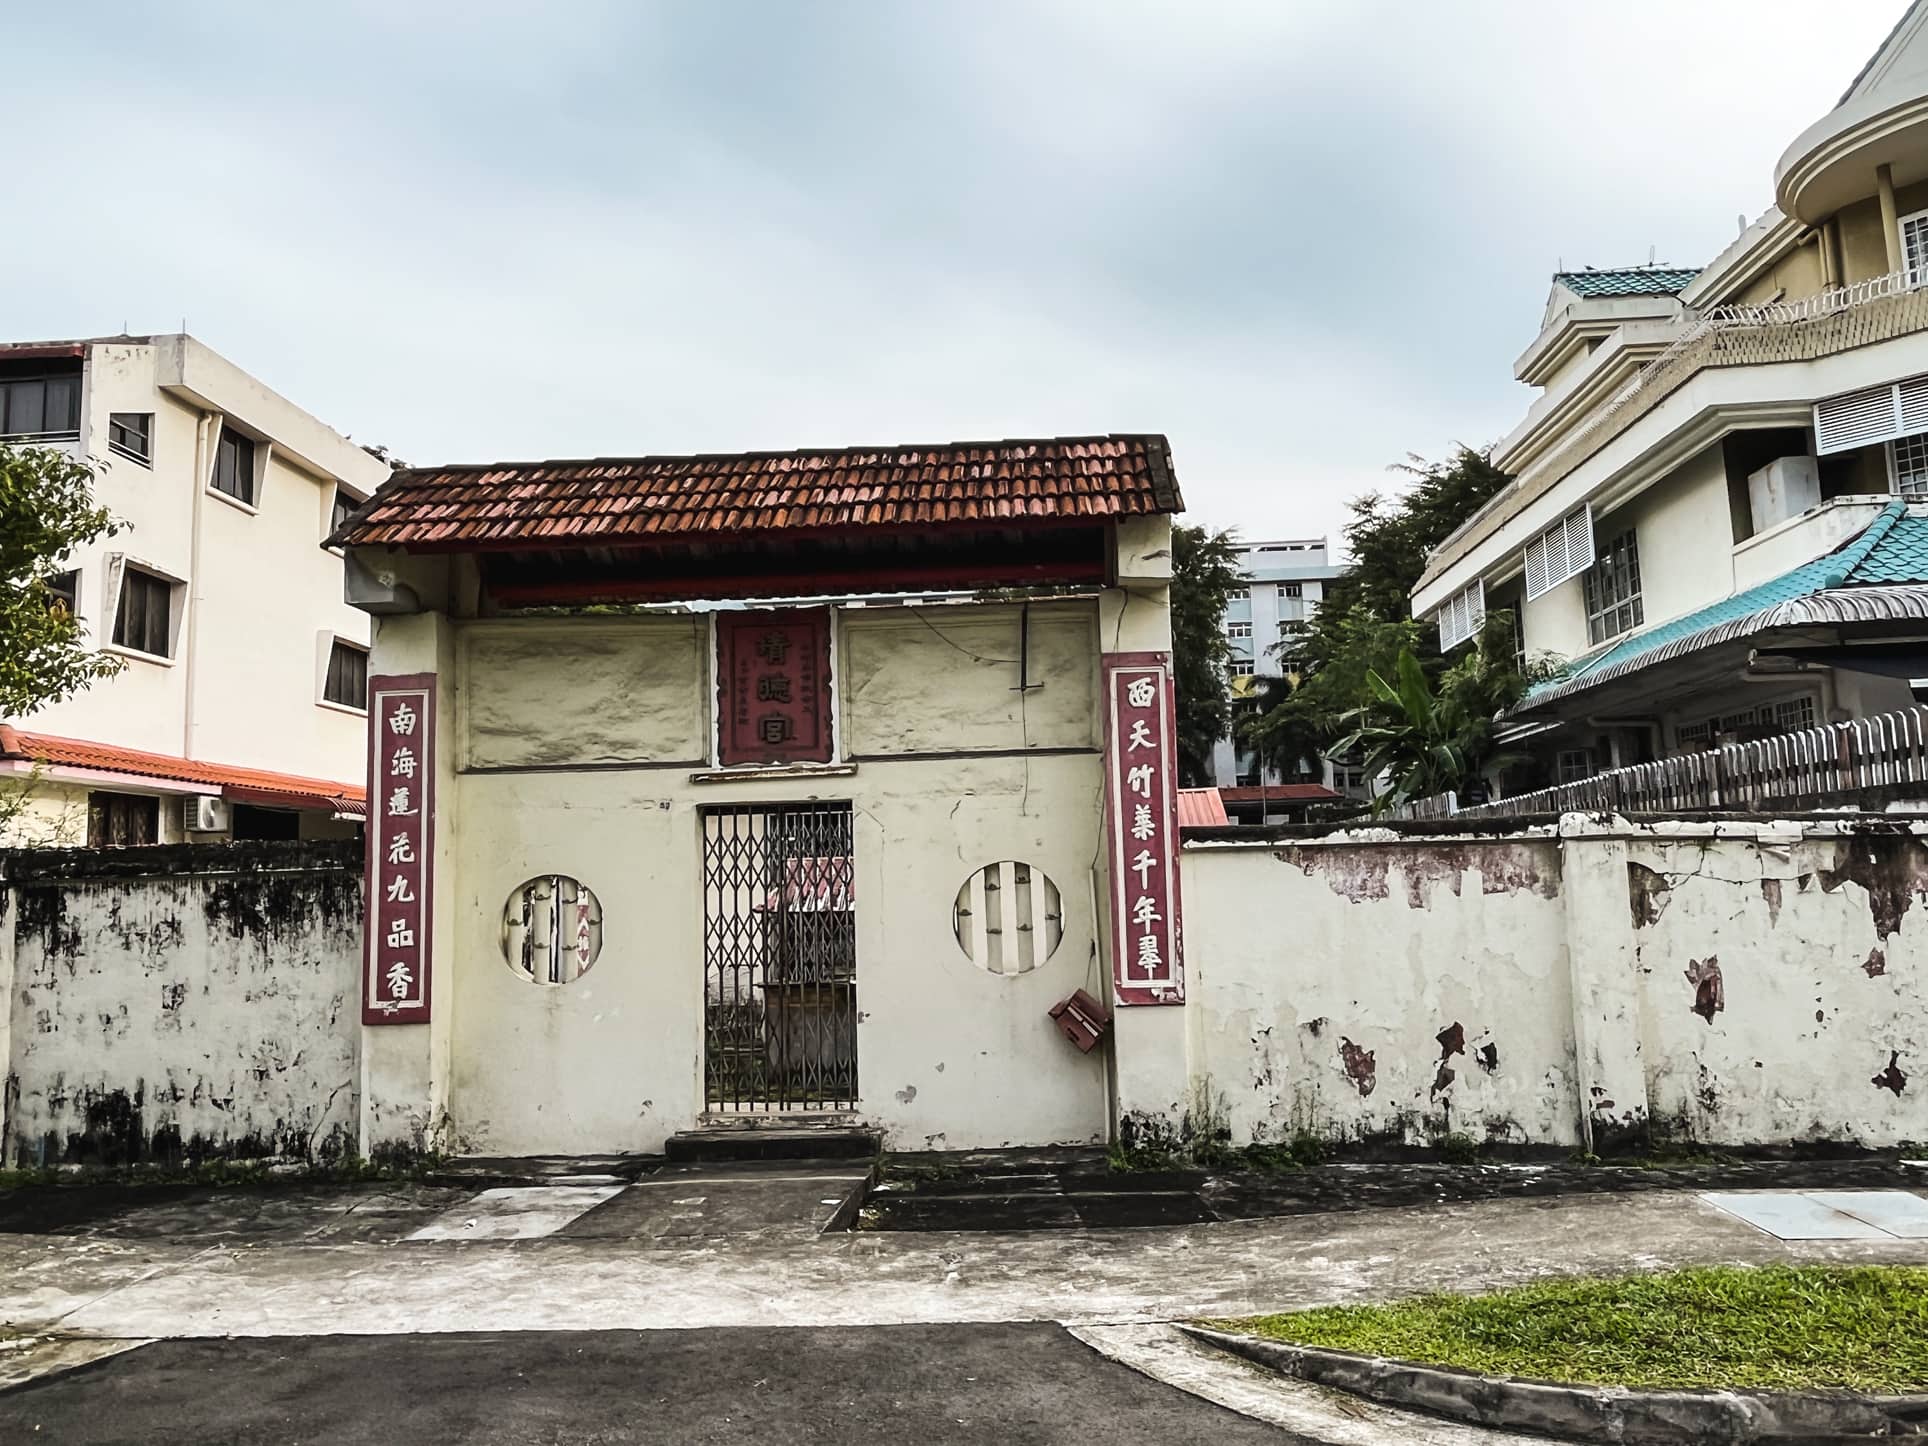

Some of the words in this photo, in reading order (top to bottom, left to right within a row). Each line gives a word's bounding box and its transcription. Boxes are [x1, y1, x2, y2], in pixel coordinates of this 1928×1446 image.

[387, 702, 418, 1000] 南海蓮花九品香
